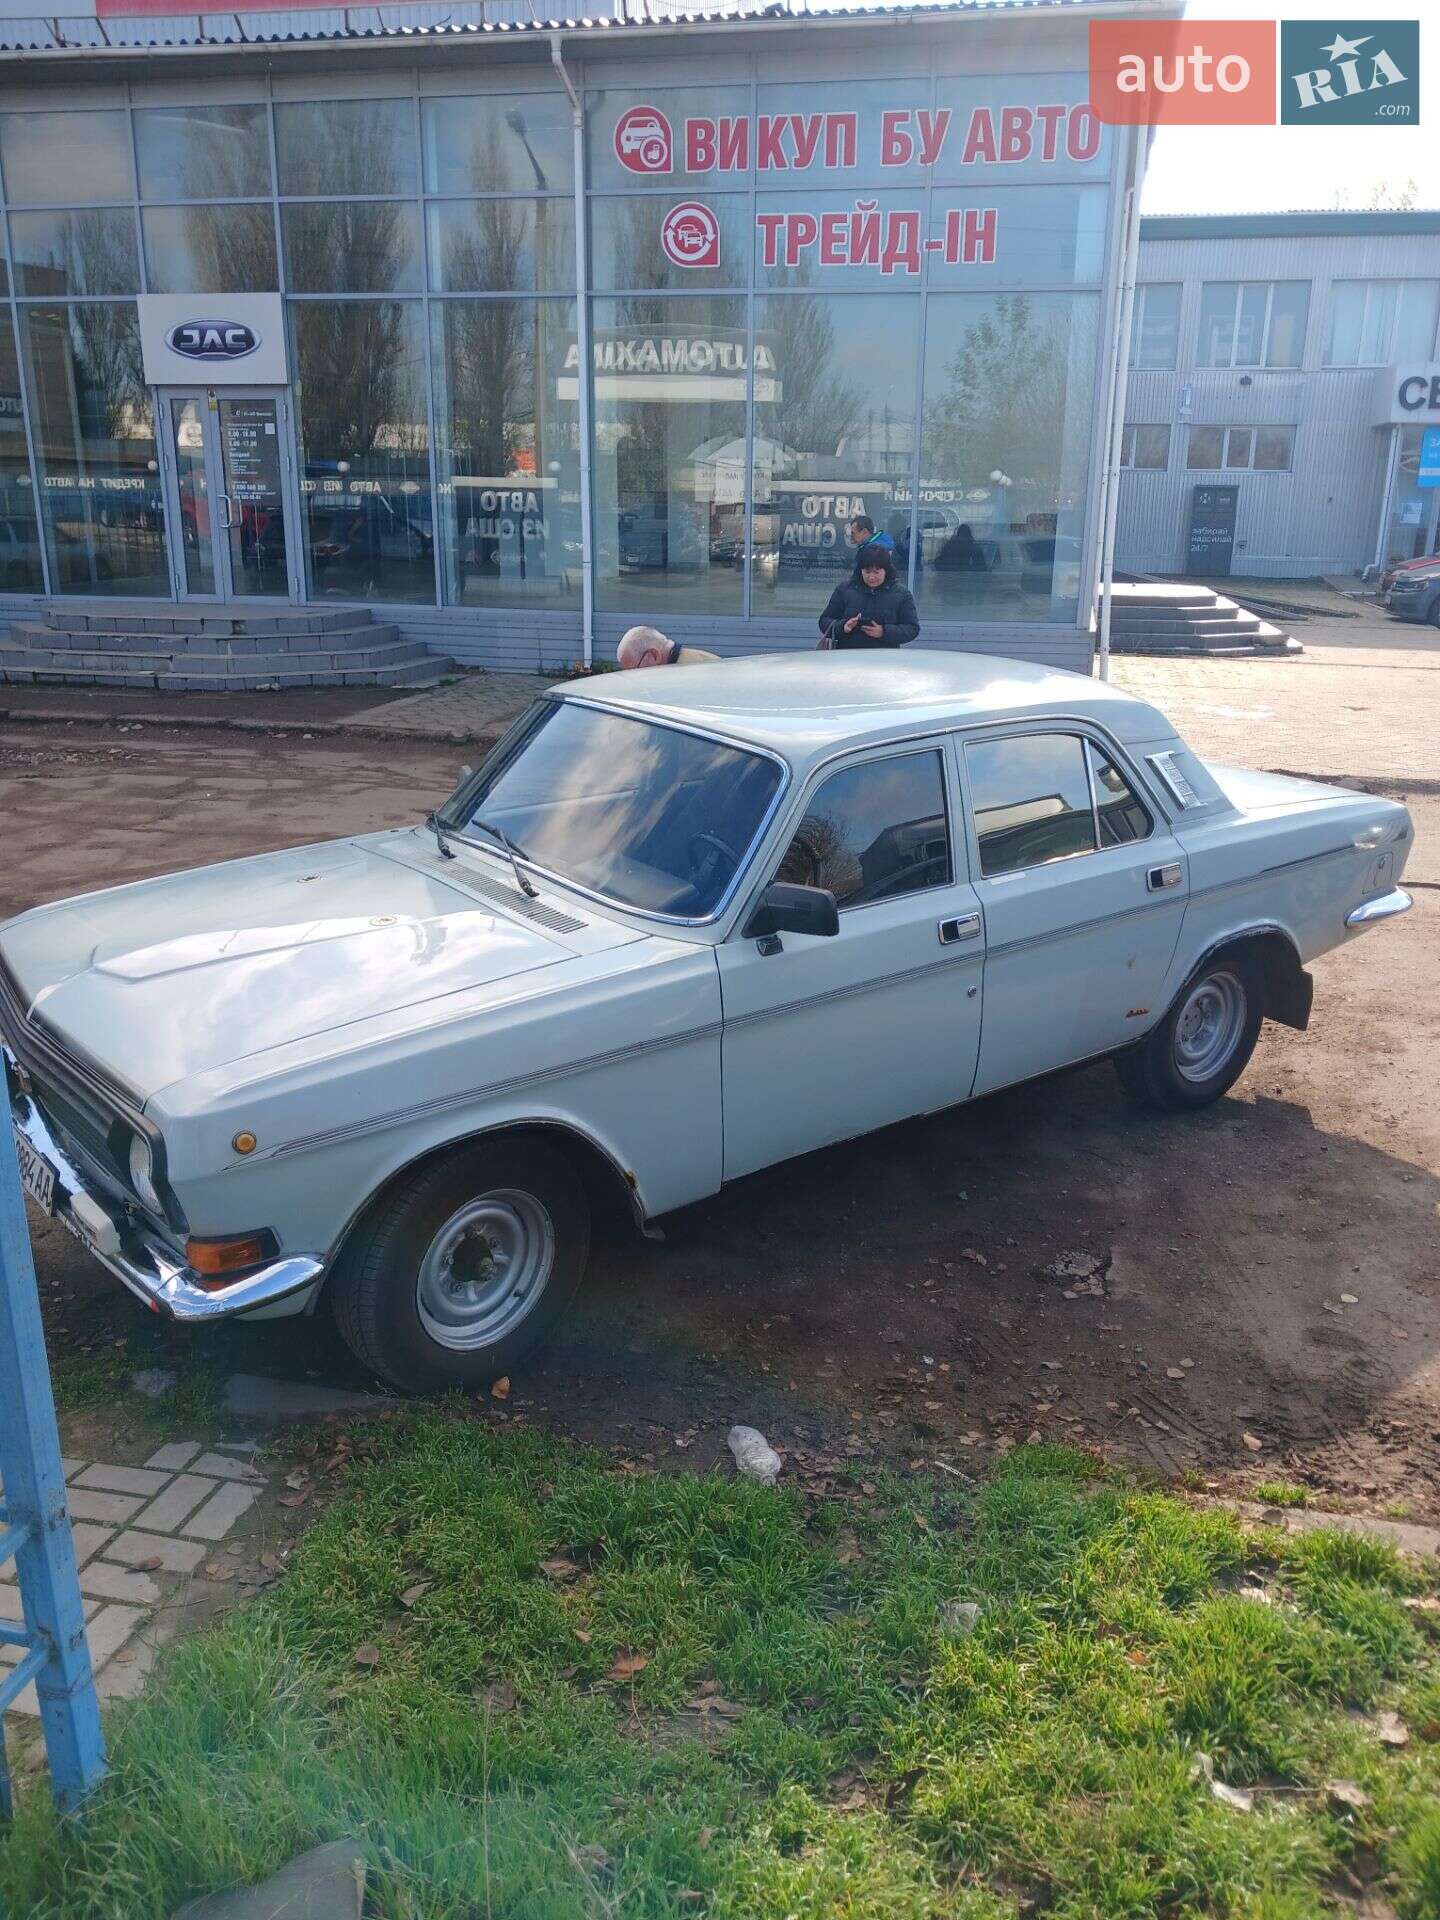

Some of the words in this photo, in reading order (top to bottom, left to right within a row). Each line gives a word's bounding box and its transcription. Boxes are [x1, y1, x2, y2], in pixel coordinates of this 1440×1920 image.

[684, 111, 858, 173] ВИКУП
[880, 108, 952, 168] БУ
[961, 103, 1101, 165] АВТО
[756, 199, 998, 275] ТРЕЙД-ІН
[180, 329, 247, 348] JAC
